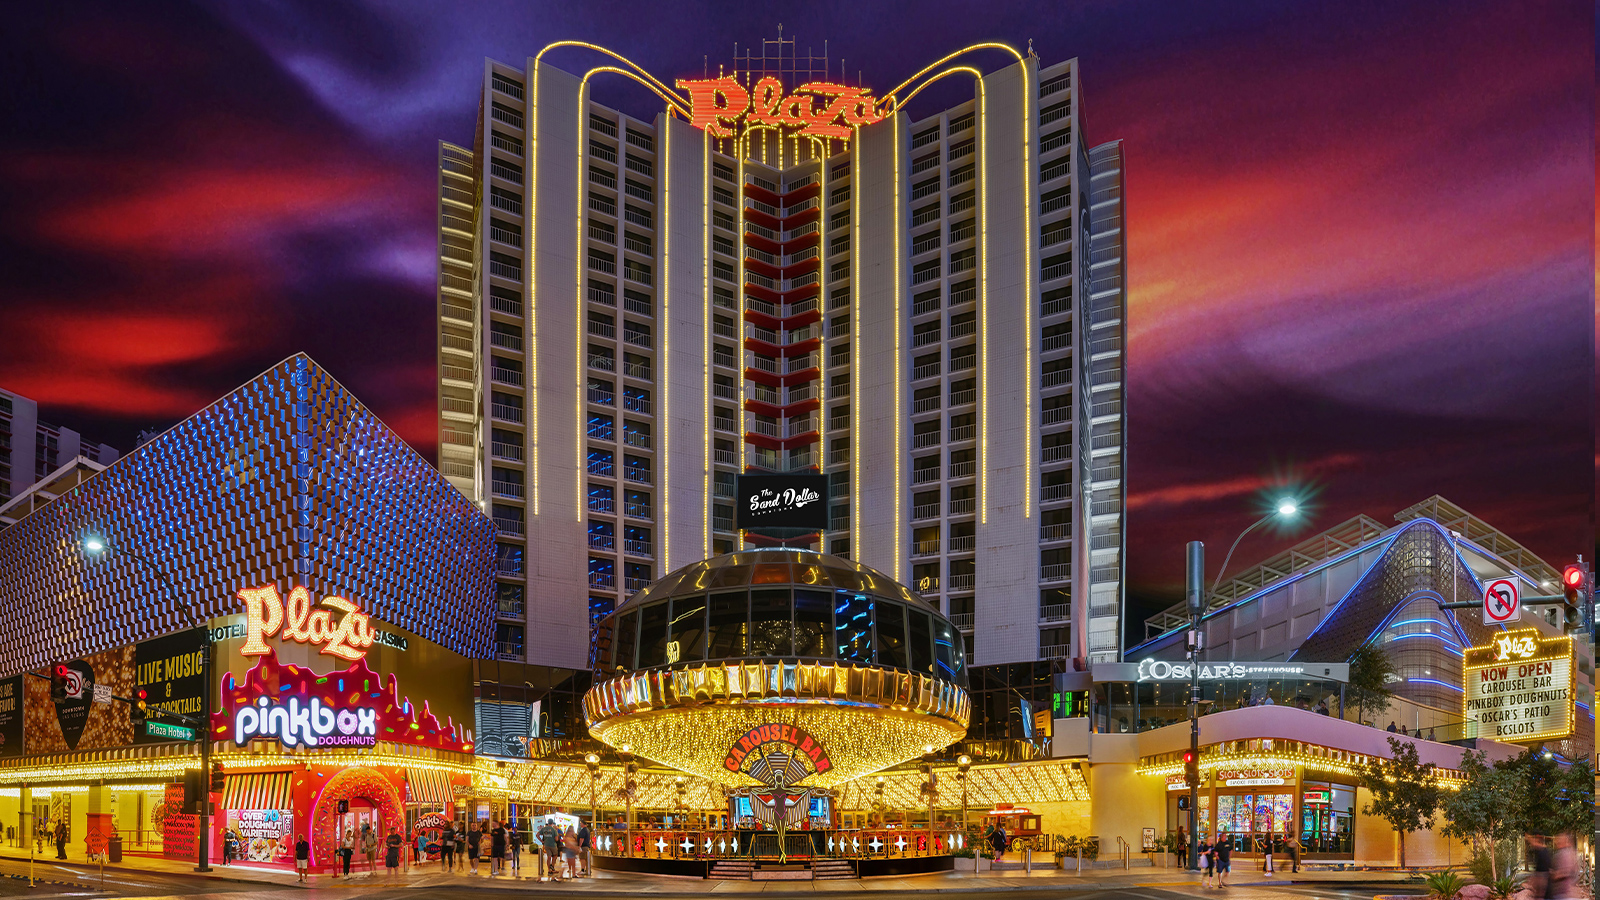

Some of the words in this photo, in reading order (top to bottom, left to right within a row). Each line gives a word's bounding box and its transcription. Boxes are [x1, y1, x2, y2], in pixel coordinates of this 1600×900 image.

[676, 75, 886, 140] Plaza
[750, 493, 780, 511] Sand
[783, 487, 820, 506] Dollar
[761, 488, 773, 497] The
[208, 624, 248, 643] HOTEL
[237, 583, 376, 661] Plaza
[373, 628, 408, 651] CASINO
[1497, 635, 1537, 661] Plaza
[138, 660, 162, 686] LIVE
[165, 650, 203, 681] MUSIC
[1481, 666, 1508, 682] NOW
[1518, 662, 1552, 678] OPEN
[165, 682, 171, 697] &
[1481, 679, 1526, 694] CAROUSEL
[1533, 676, 1552, 688] BAR
[160, 696, 202, 718] COCKTAILS
[1467, 696, 1504, 710] PINKBOX
[1510, 688, 1567, 705] DOUGHNUTS
[235, 696, 376, 745] pinkbox
[1481, 709, 1518, 723] OSCAR'S
[1524, 705, 1551, 718] PATIO
[148, 723, 167, 736] Plaza
[168, 726, 185, 738] Hotel
[1496, 722, 1535, 736] BCSLOTS
[319, 736, 376, 746] DOUGHNUTS
[725, 723, 799, 771] CAROUSEL
[799, 735, 830, 774] BAR
[1219, 770, 1240, 780] SLOTS
[1243, 769, 1264, 779] SLOTS
[1268, 768, 1293, 778] SLOTS
[242, 812, 263, 820] OVER
[263, 809, 279, 822] 70
[238, 820, 282, 830] DOUGHNUT
[241, 828, 280, 838] VARIETIES
